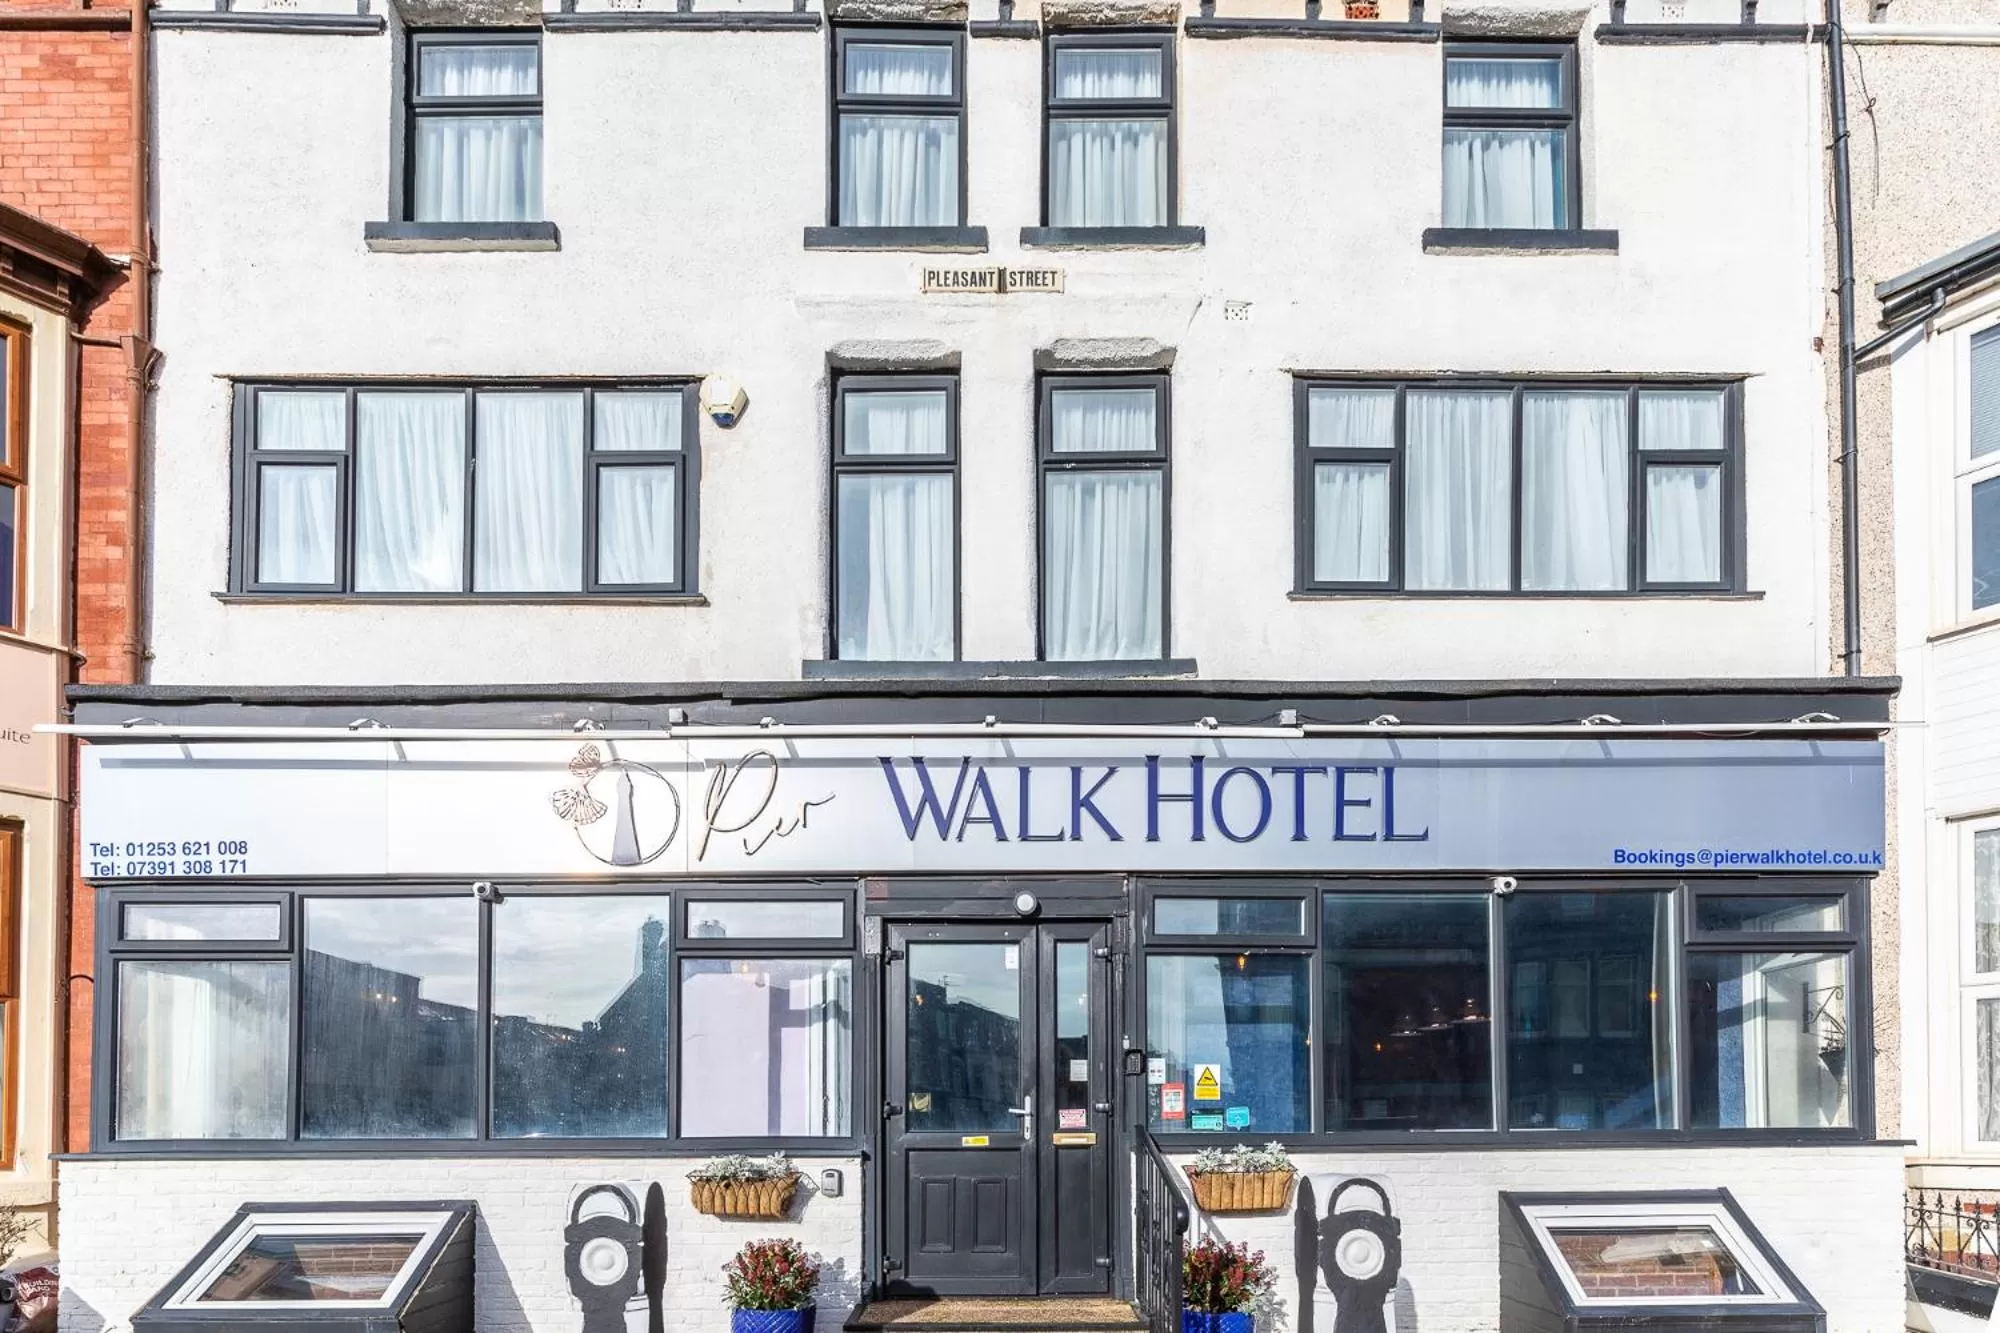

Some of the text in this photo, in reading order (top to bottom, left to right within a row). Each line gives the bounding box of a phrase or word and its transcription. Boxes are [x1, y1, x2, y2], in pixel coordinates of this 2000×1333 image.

[927, 270, 1058, 287] PLEASANT STREET
[877, 756, 1125, 842] WALK
[1145, 755, 1429, 843] HOTEL
[89, 840, 248, 857] Tel: 01253 621 008
[90, 859, 247, 876] Tel: 07391 308 171
